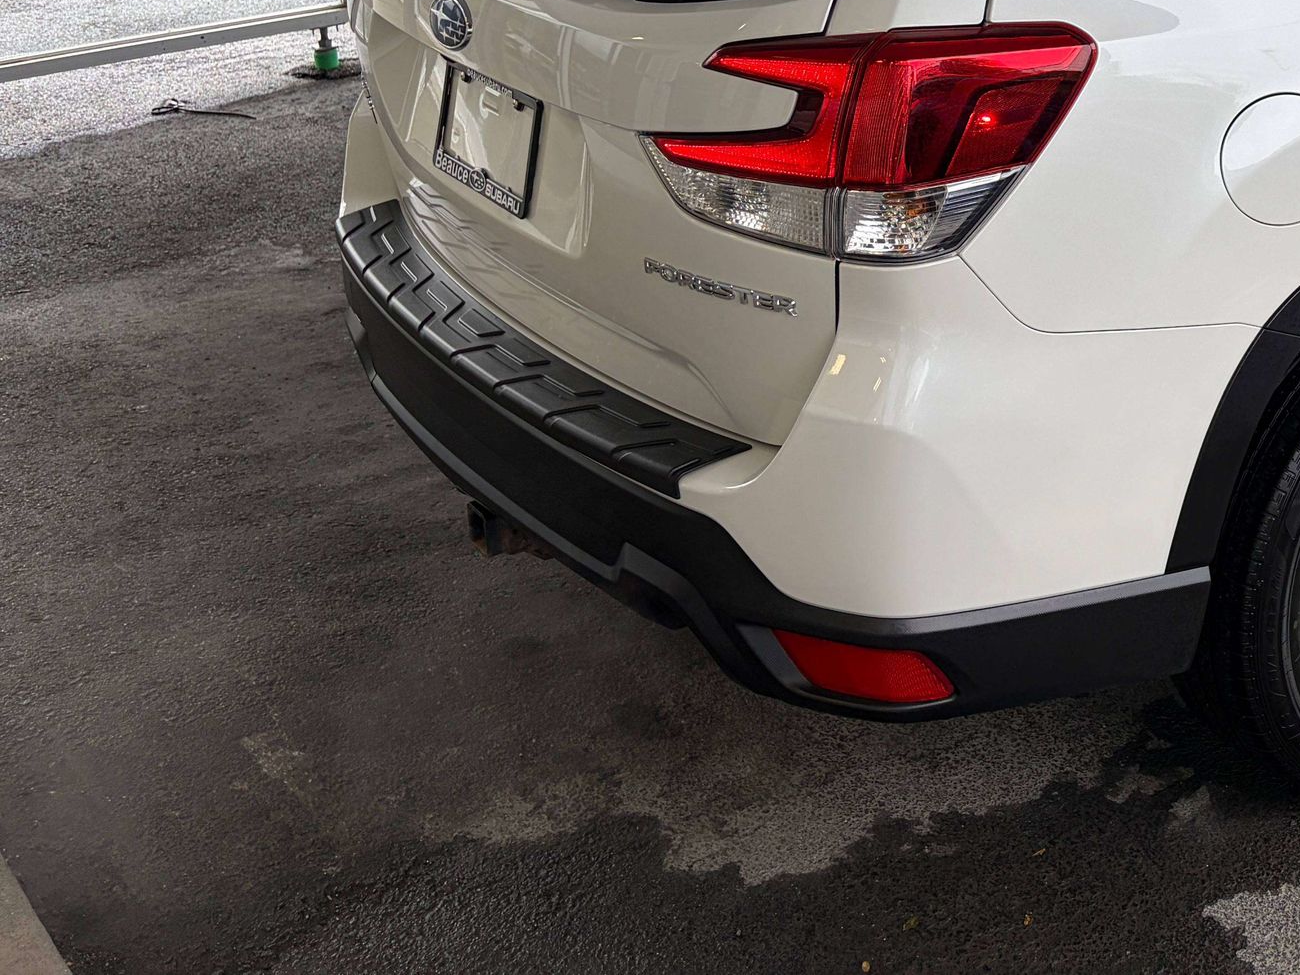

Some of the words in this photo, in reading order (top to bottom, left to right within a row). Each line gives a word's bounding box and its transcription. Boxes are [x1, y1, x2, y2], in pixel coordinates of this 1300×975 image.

[435, 148, 469, 184] Beauce
[485, 183, 521, 214] SUBARU
[644, 257, 798, 317] FORESTER
